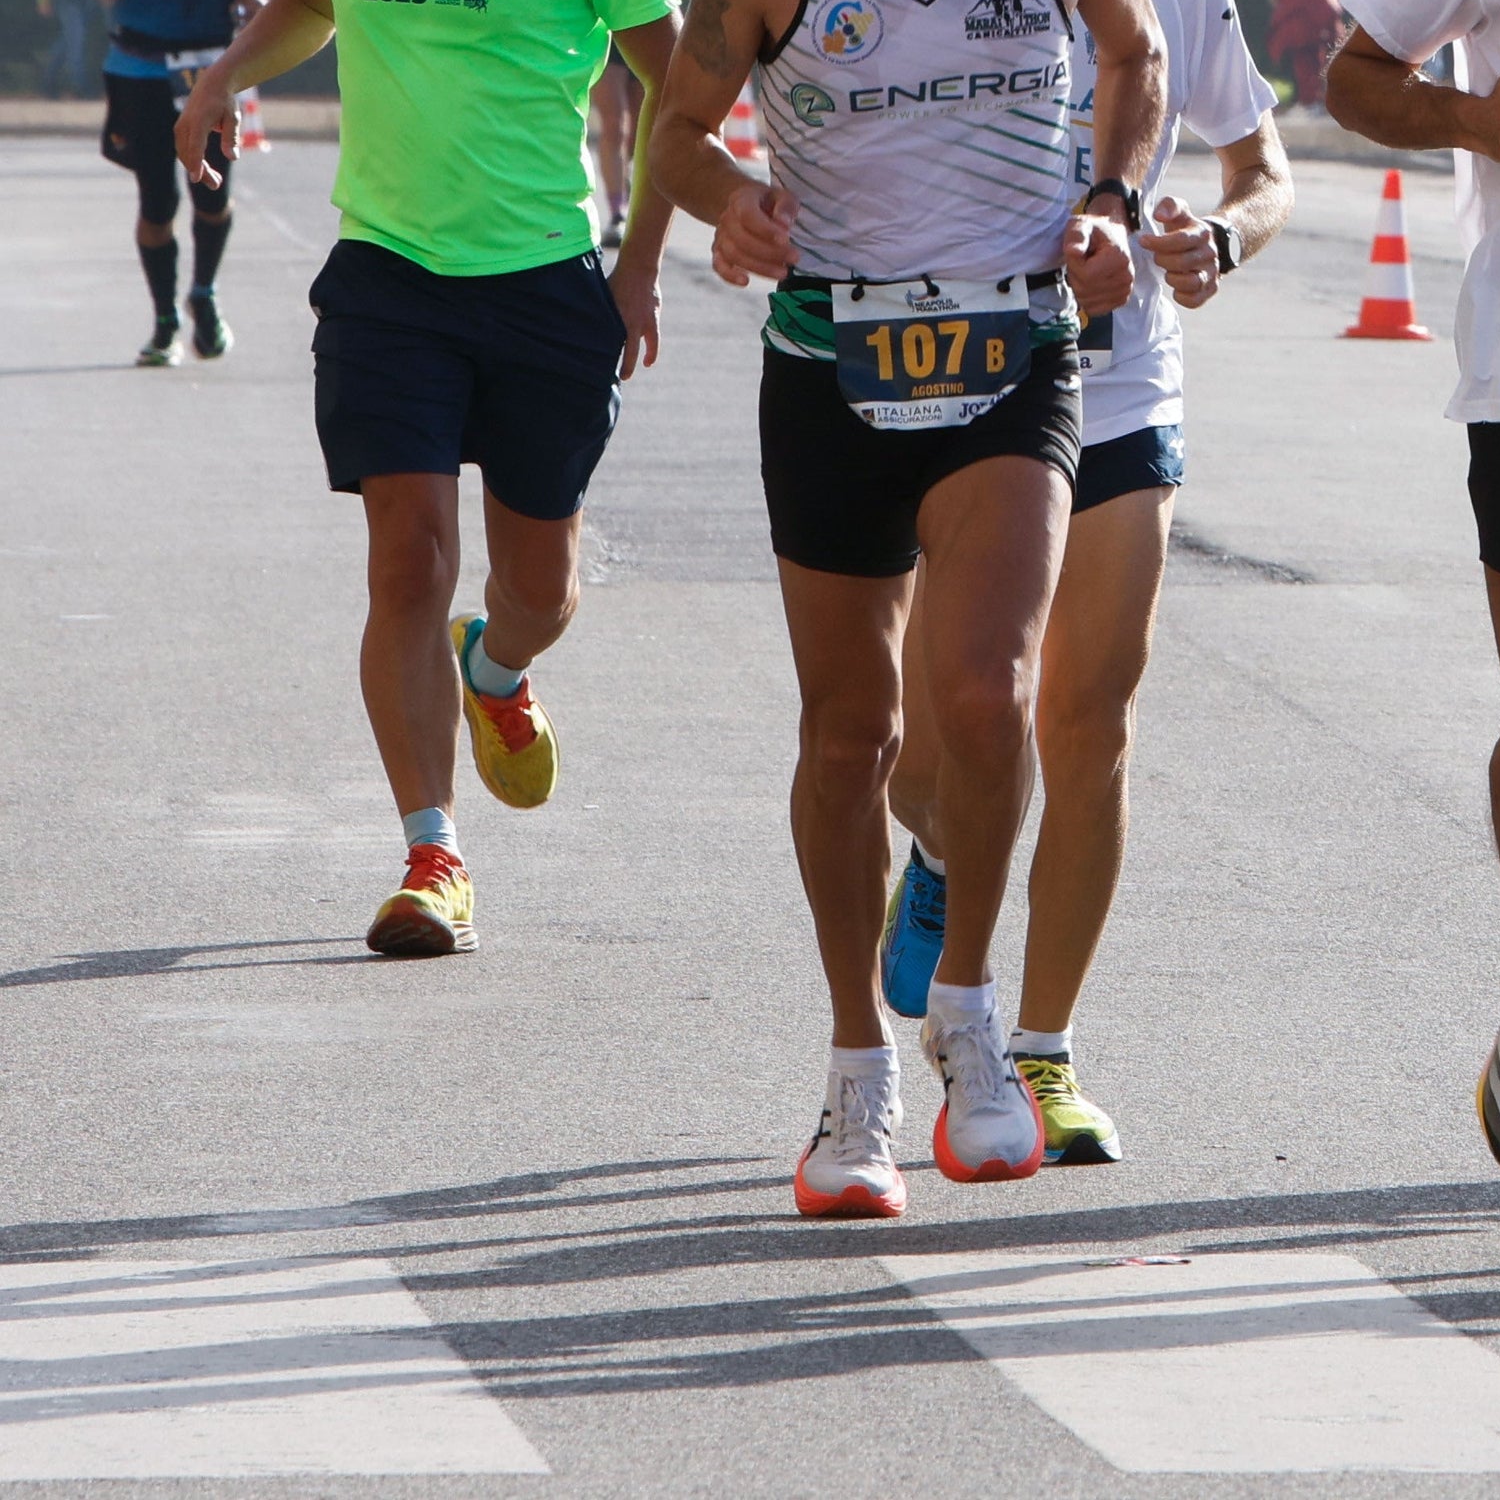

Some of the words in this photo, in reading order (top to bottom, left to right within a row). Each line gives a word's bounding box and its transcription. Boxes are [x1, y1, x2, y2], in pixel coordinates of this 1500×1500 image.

[850, 61, 1067, 112] ENERGIA
[866, 320, 970, 380] 107
[986, 338, 1005, 373] B
[911, 383, 964, 398] AGOSTINO
[877, 404, 942, 417] ITALIANA
[878, 414, 942, 424] ASSICURAZIONI
